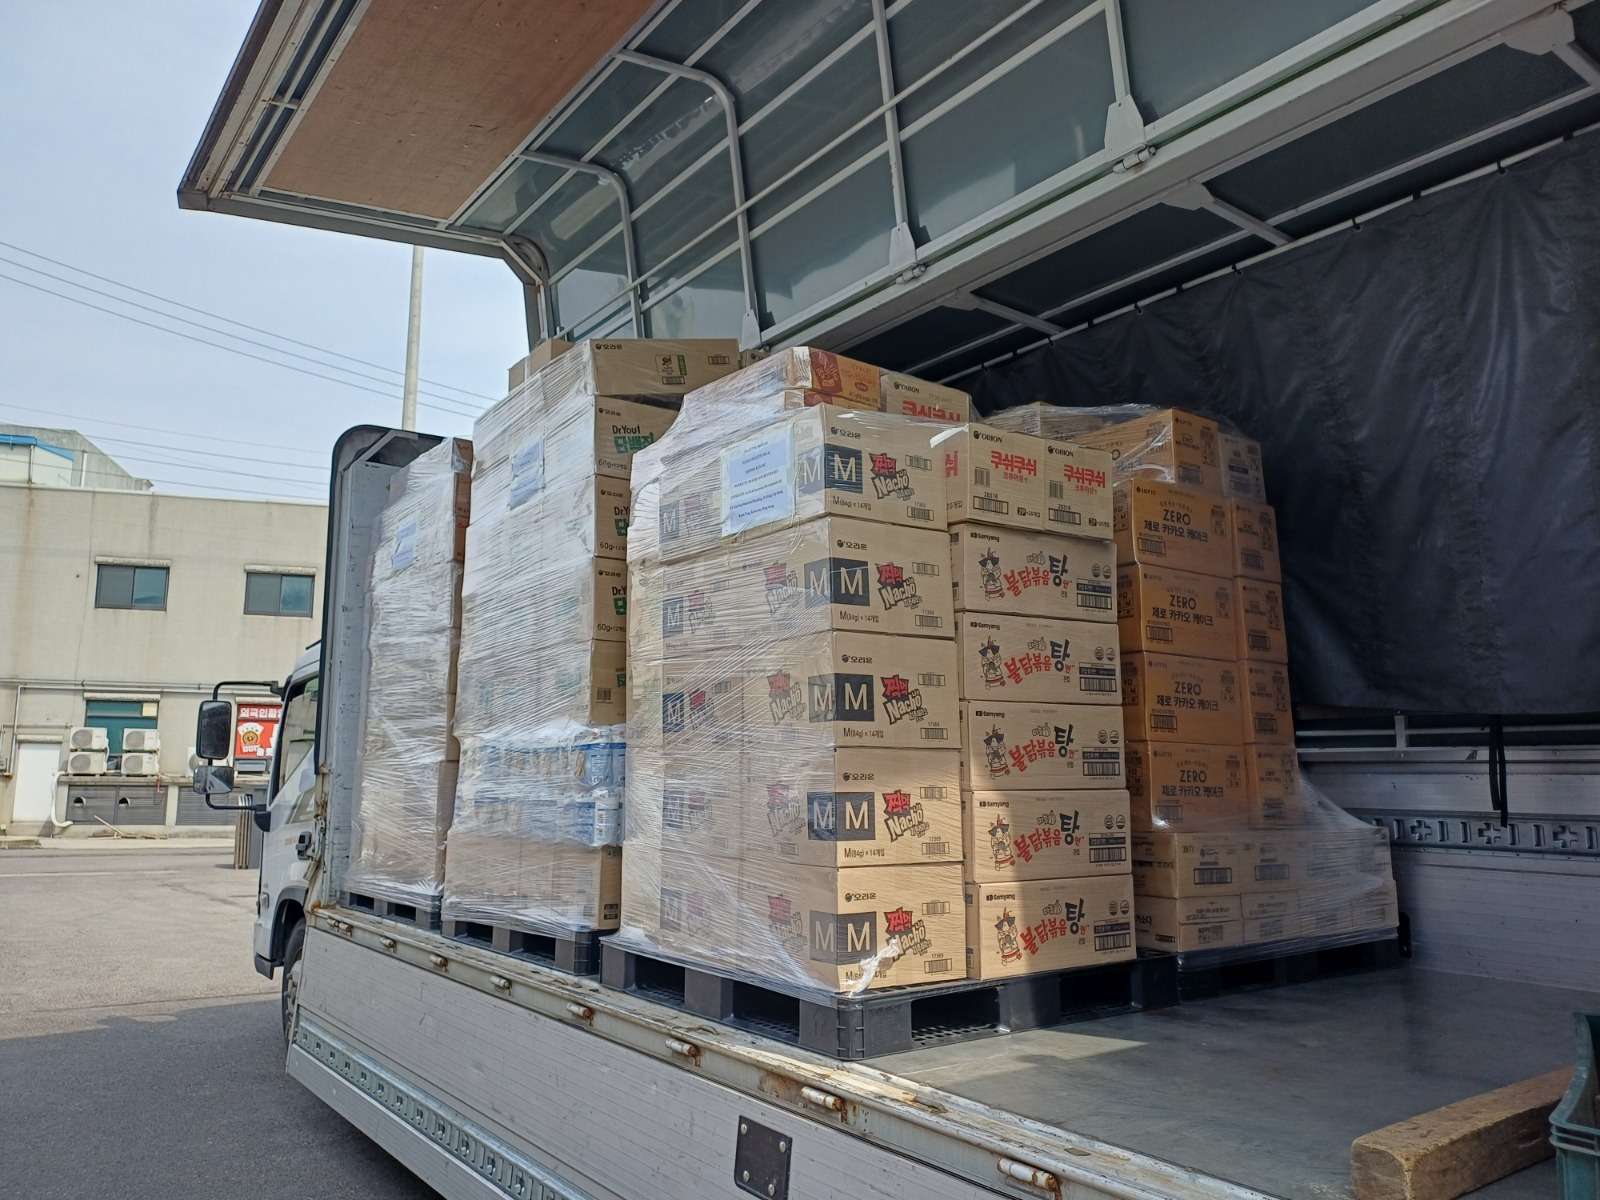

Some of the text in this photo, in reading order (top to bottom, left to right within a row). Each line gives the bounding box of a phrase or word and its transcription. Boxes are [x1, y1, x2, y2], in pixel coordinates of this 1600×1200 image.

[981, 434, 1002, 443] ORION
[1054, 447, 1074, 457] ORION
[833, 453, 856, 482] M
[872, 472, 910, 499] Nacho
[1163, 508, 1191, 526] ZERO
[1143, 519, 1160, 532] 제로
[1162, 523, 1185, 538] 카카오
[1186, 528, 1208, 543] 케이크
[809, 567, 827, 597] M
[840, 567, 863, 596] M
[880, 580, 917, 610] Nacho
[1169, 594, 1197, 610] ZERO
[1152, 606, 1167, 619] 제로
[1169, 610, 1191, 623] 카카오
[1192, 613, 1213, 626] 케이크
[814, 682, 832, 712] M
[844, 682, 868, 711] M
[1174, 681, 1201, 695] ZERO
[884, 693, 922, 725] Nacho
[1156, 695, 1219, 711] 제로 카카오 케이크
[851, 773, 875, 781] 오리온
[1179, 769, 1207, 784] ZERO
[1161, 785, 1177, 797] 제로
[1178, 785, 1201, 797] 카카오
[813, 801, 833, 830] M
[845, 801, 869, 830] M
[884, 808, 924, 843] Nacho
[854, 892, 877, 901] 오리온
[815, 921, 834, 953] M
[847, 921, 871, 953] M
